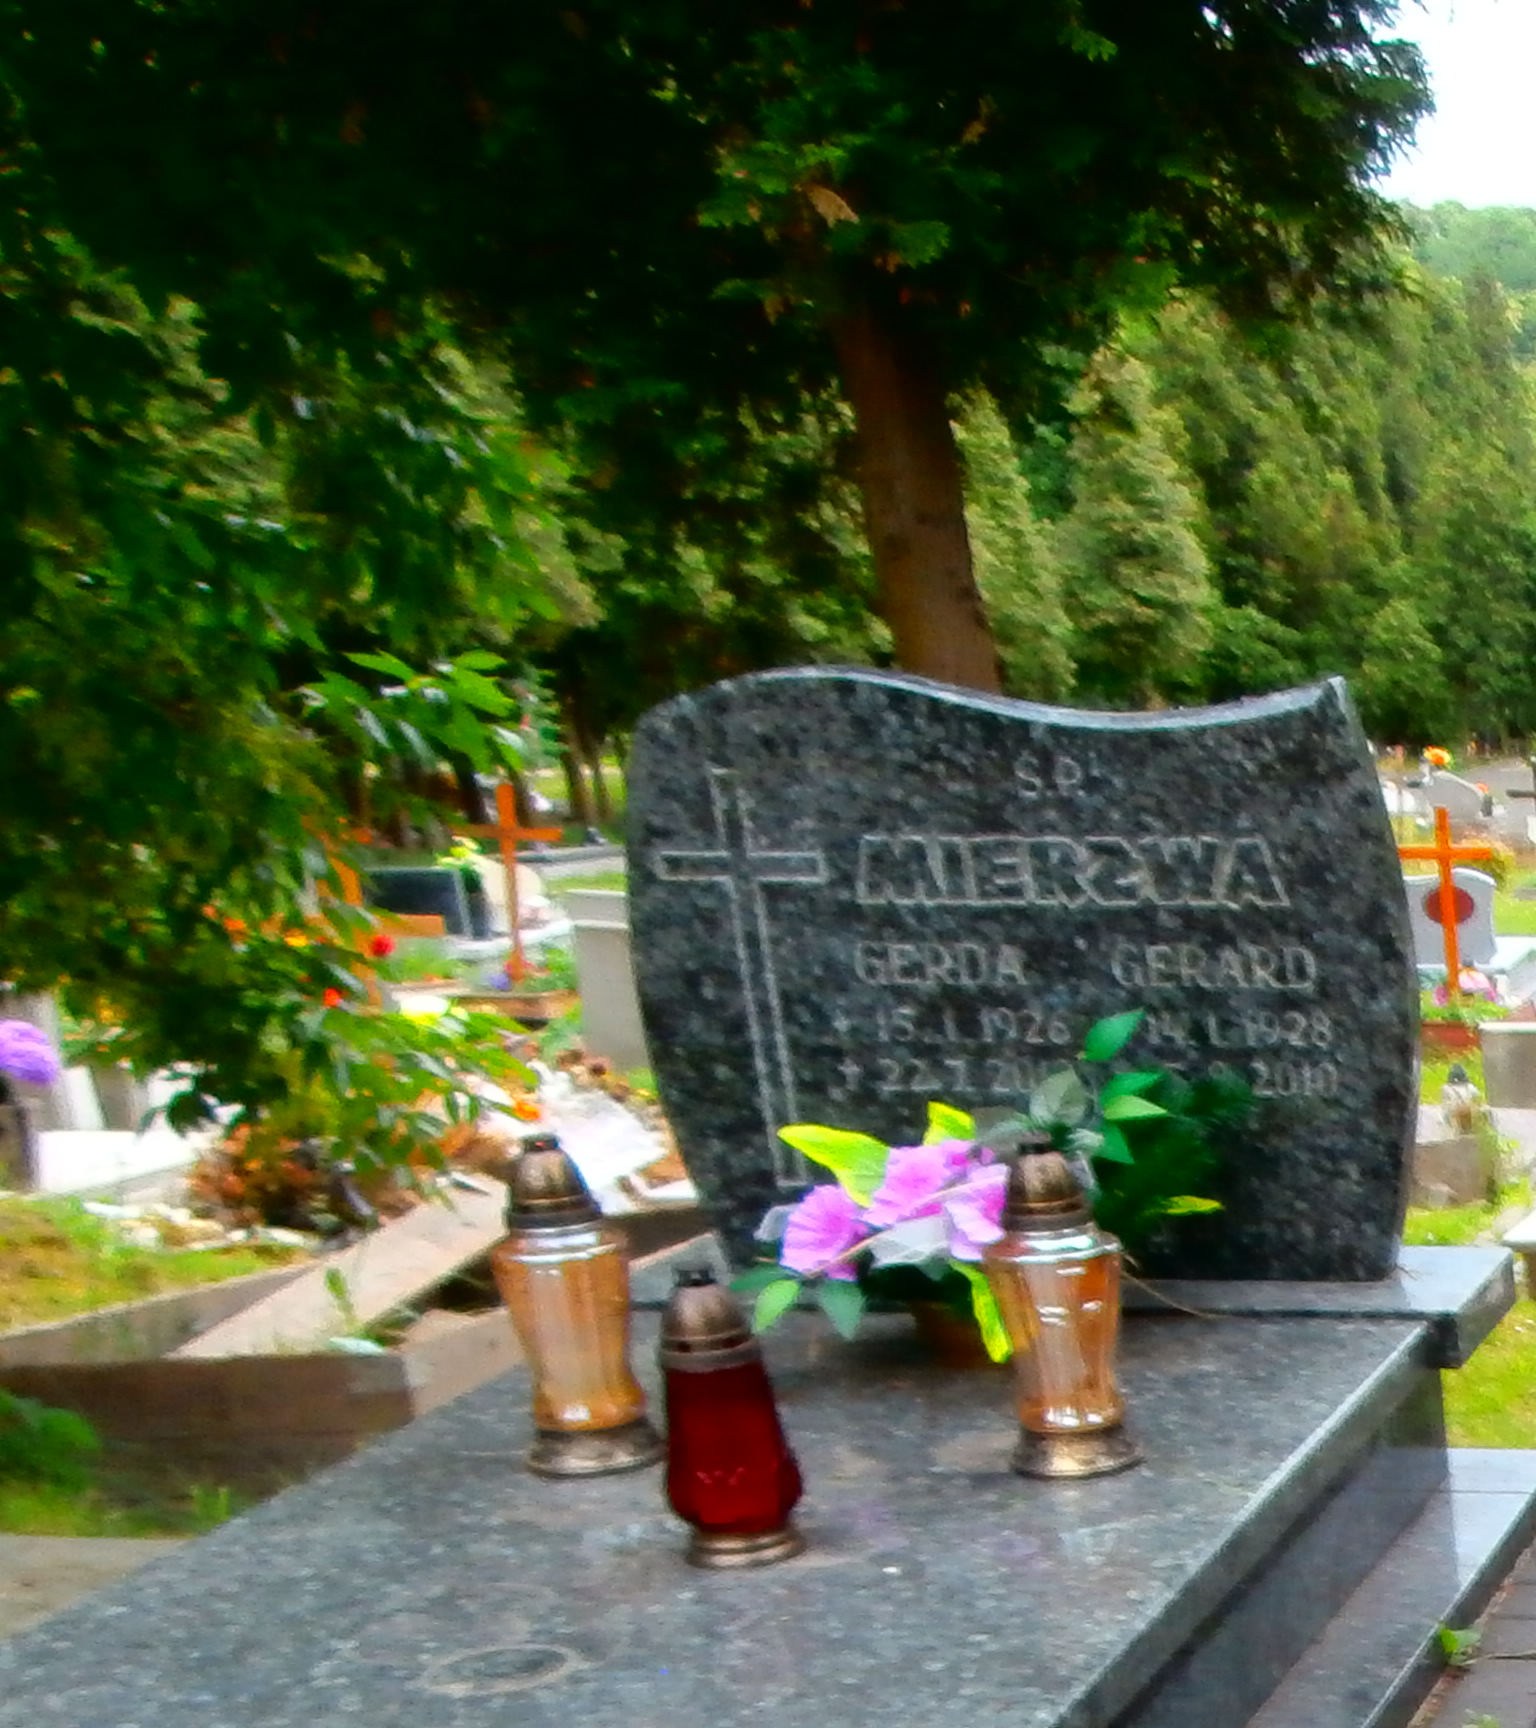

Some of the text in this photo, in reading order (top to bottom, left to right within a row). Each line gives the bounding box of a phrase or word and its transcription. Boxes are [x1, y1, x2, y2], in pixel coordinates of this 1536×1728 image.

[855, 833, 1292, 911] MIERZWA
[854, 940, 1319, 989] GERDA GERARD
